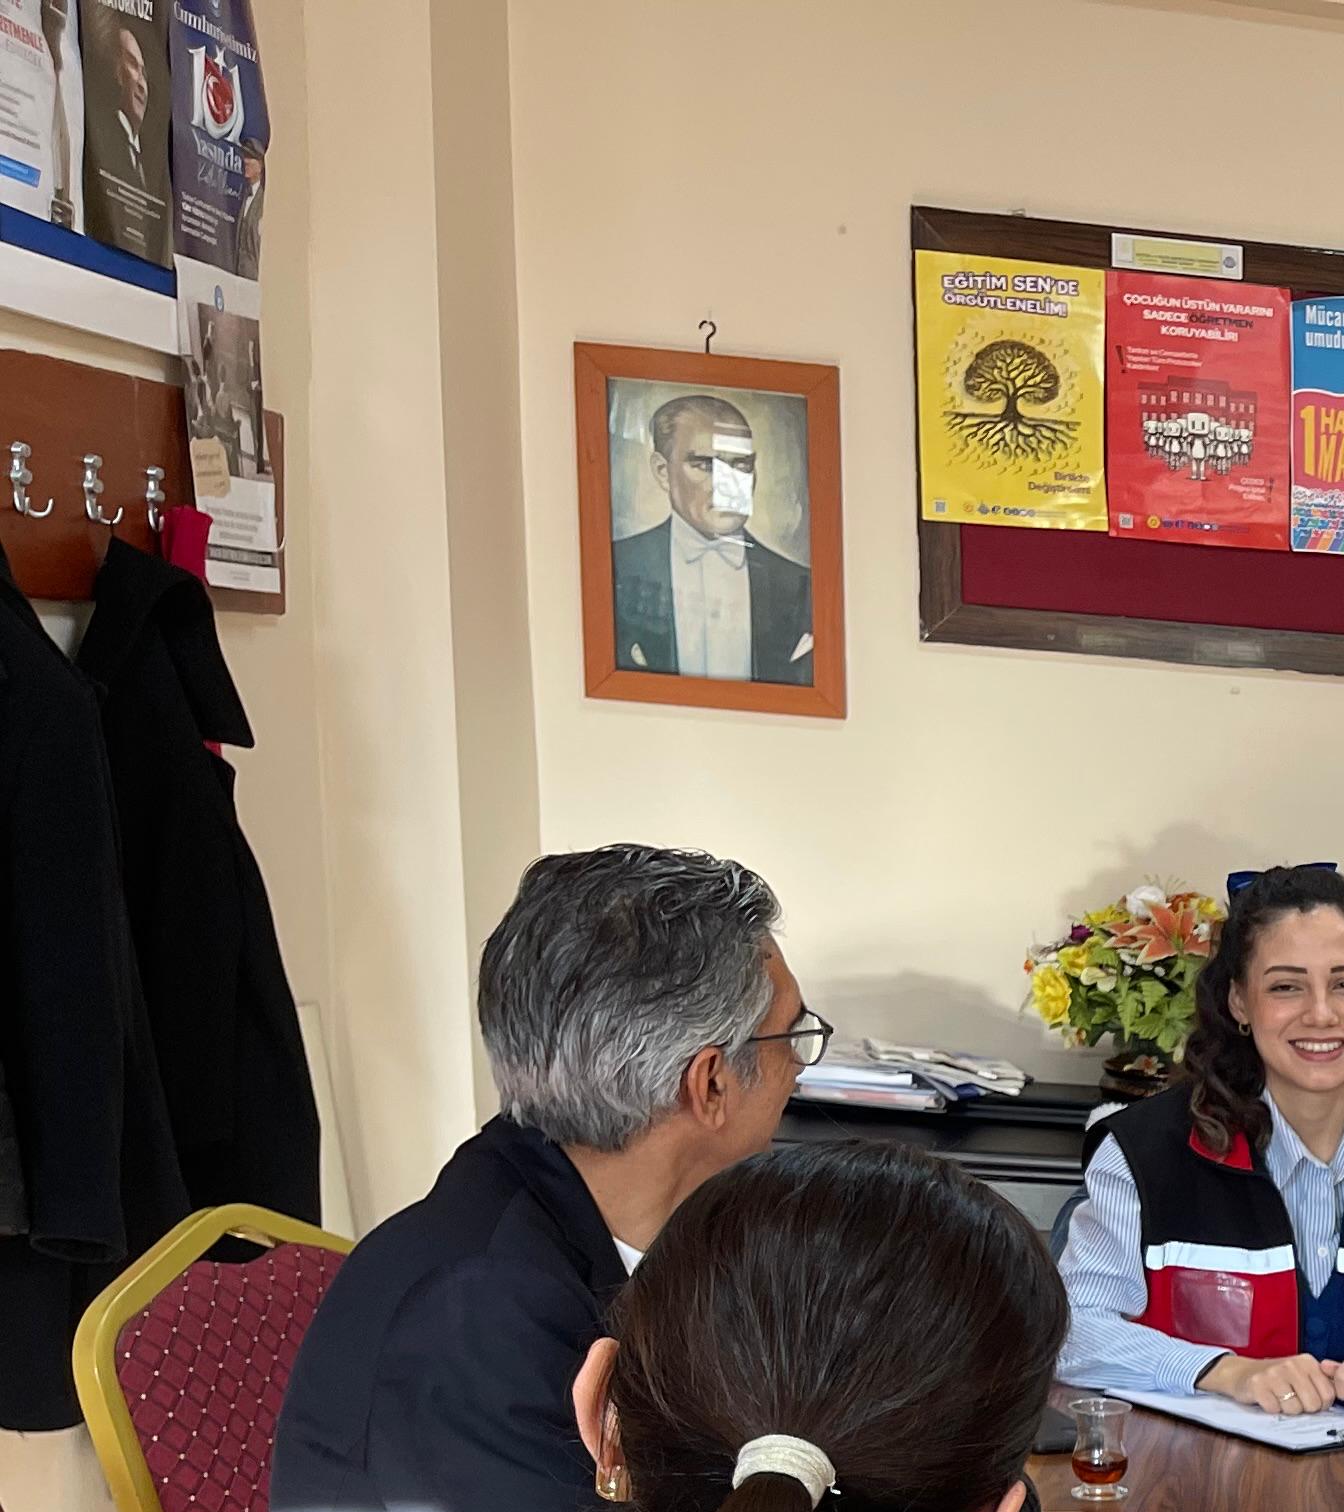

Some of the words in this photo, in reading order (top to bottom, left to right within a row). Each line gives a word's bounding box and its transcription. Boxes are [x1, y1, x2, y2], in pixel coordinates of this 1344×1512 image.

[943, 272, 1007, 291] EĞİTİM
[1013, 275, 1079, 296] SEN'DE
[943, 290, 1068, 317] ÖRGÜTLENELİM!
[1123, 293, 1181, 309] ÇOCUĞUN
[1182, 297, 1221, 312] ÜSTÜN
[1143, 309, 1188, 323] SADECE
[1300, 405, 1315, 476] 1
